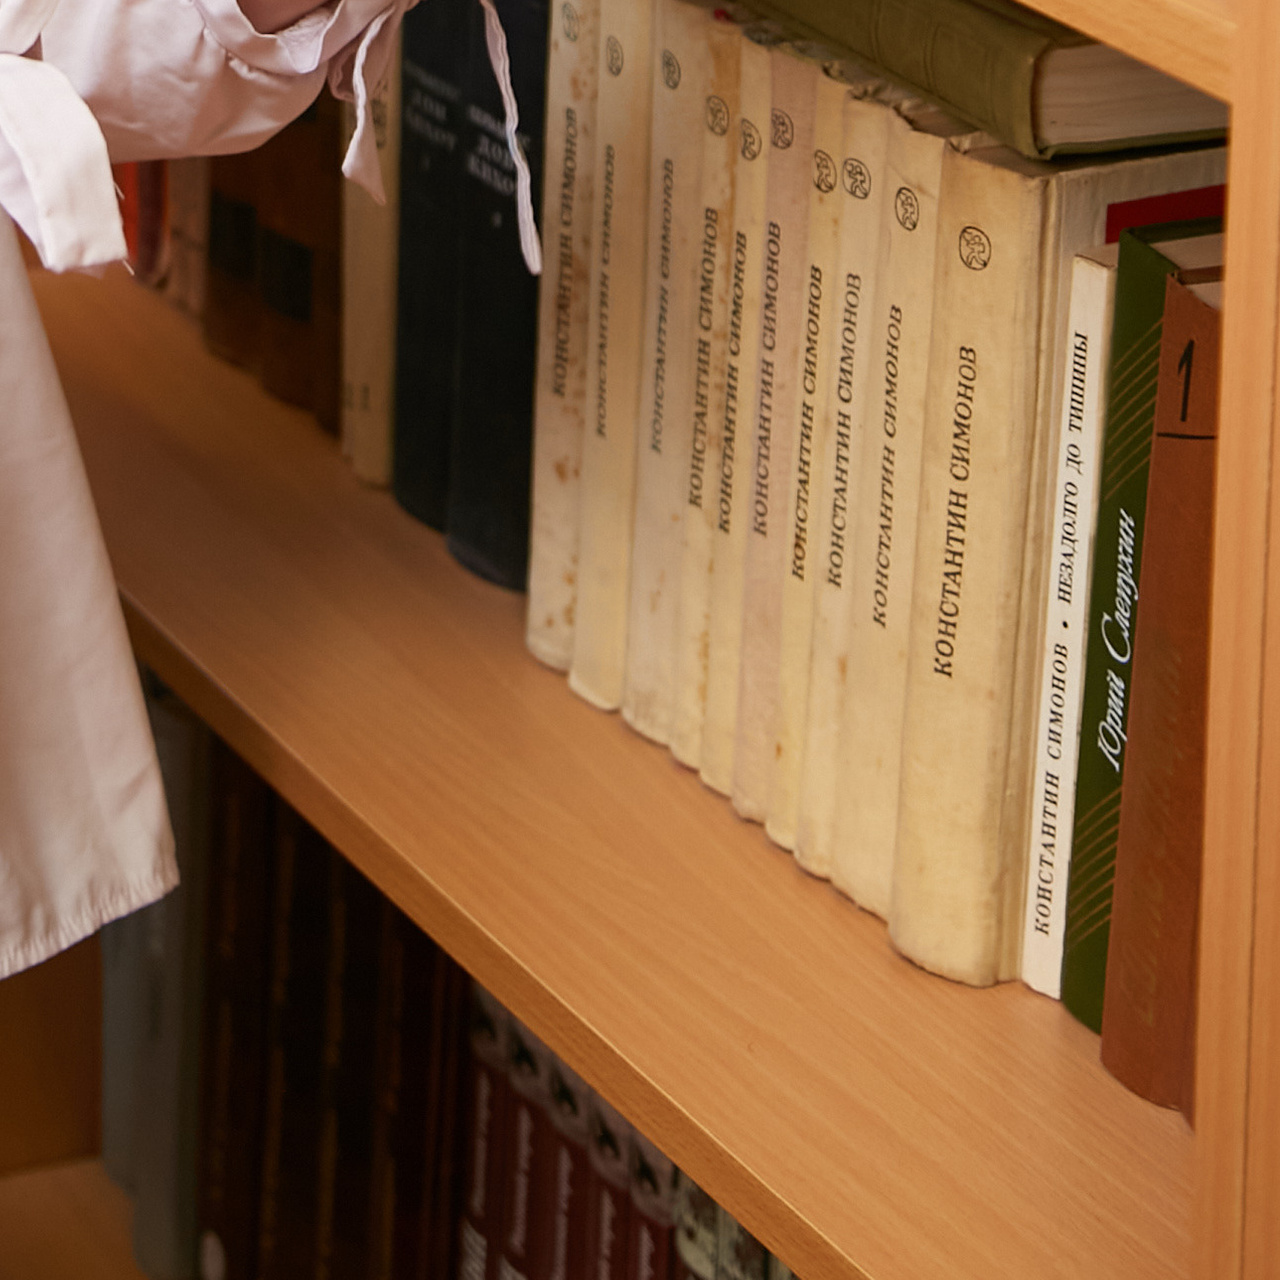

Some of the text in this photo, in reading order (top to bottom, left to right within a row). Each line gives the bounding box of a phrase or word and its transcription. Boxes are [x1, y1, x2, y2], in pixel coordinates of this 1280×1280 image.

[552, 107, 579, 397] КОНСТАНТИН СИМОНОВ
[651, 159, 675, 453] КОНСТАНТИН СИМОНОВ
[688, 207, 719, 509] КОНСТАНТИН СИМОНОВ
[717, 231, 748, 535] КОНСТАНТИН СИМОНОВ
[753, 221, 783, 537] КОНСТАНТИН СИМОНОВ
[1177, 339, 1195, 423] 1
[790, 264, 824, 581] КОНСТАНТИН СИМОНОВ
[827, 273, 863, 588] КОНСТАНТИН СИМОНОВ
[872, 304, 903, 628] КОНСТАНТИН СИМОНОВ
[933, 345, 978, 678] КОНСТАНТИН СИМОНОВ
[1034, 331, 1089, 936] КОНСТАНТИН СИМОНОВ НЕЗАДОЛГО ДО ТИШИНЫ
[1097, 507, 1139, 772] Юрий Слепухин
